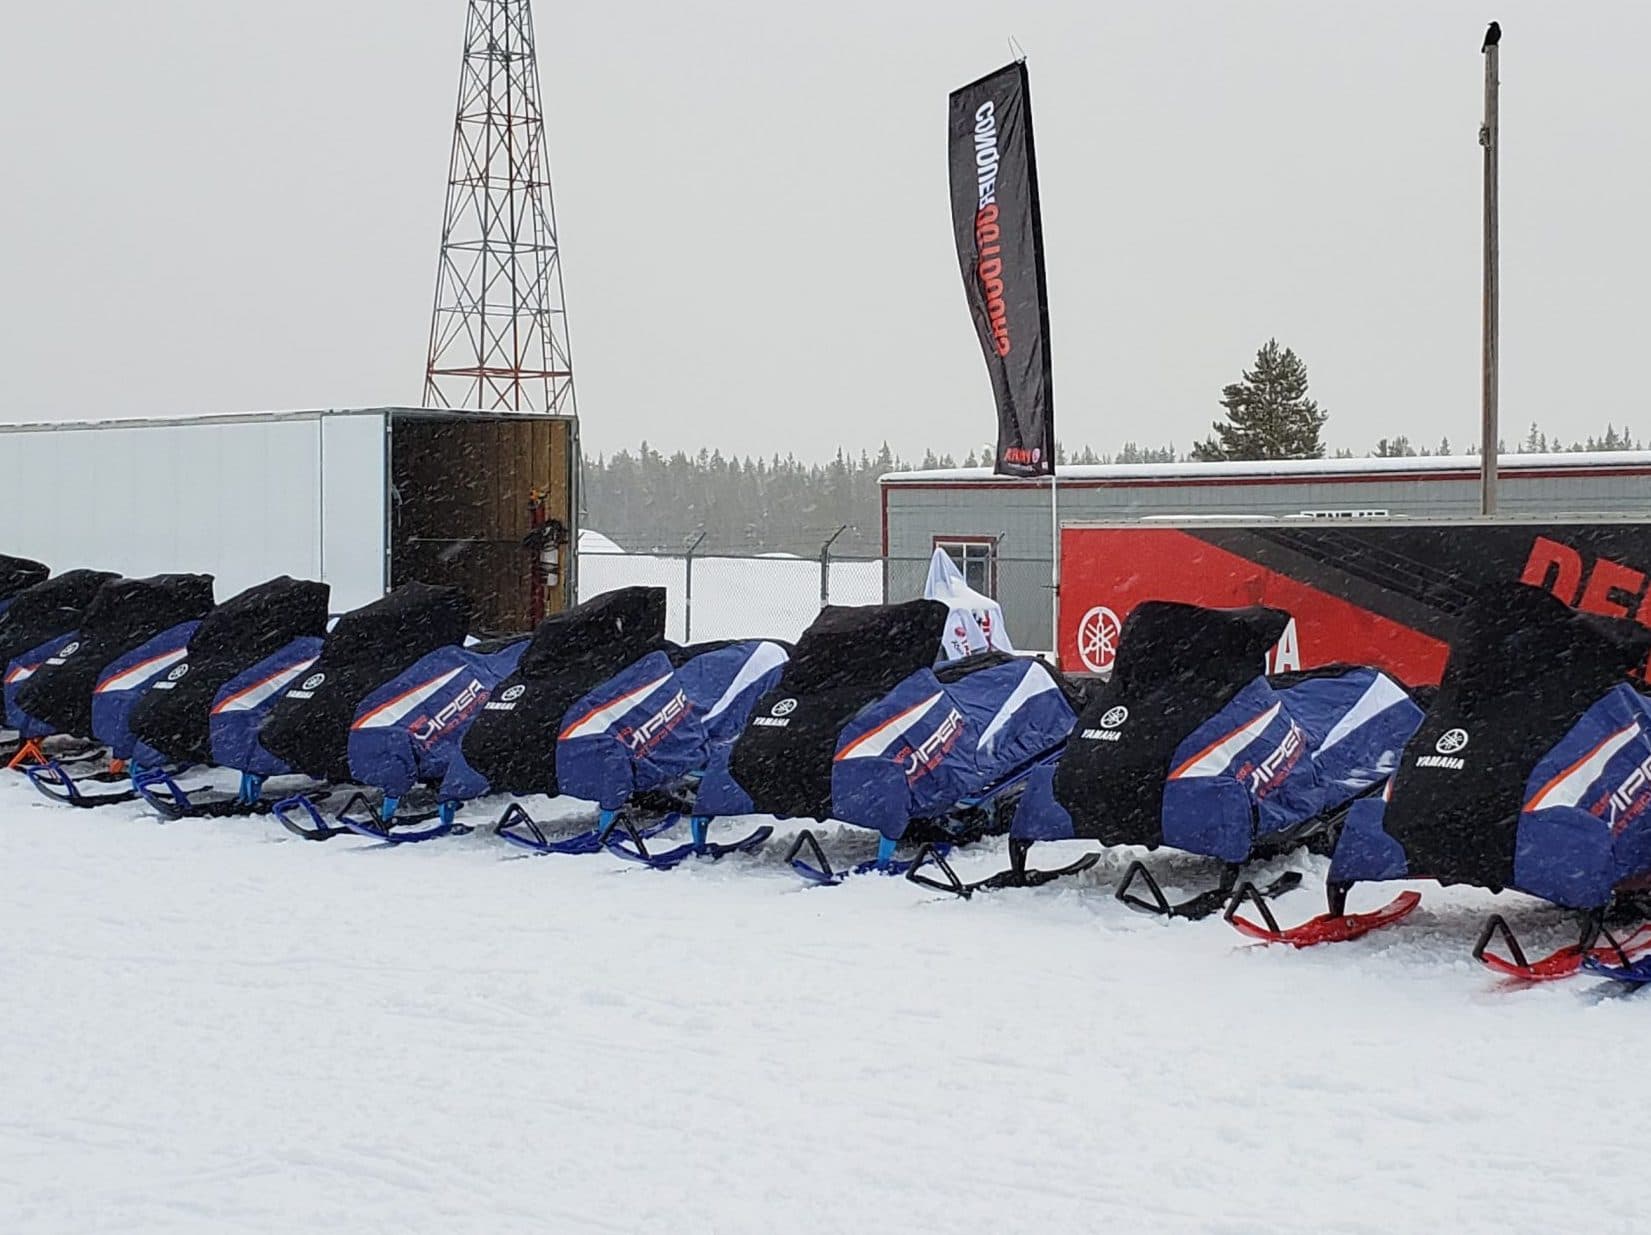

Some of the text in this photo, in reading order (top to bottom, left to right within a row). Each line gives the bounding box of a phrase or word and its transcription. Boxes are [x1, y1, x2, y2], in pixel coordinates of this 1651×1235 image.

[413, 678, 485, 741] VIPER
[1081, 728, 1121, 741] YAMAHA
[1416, 755, 1465, 769] YAMAHA
